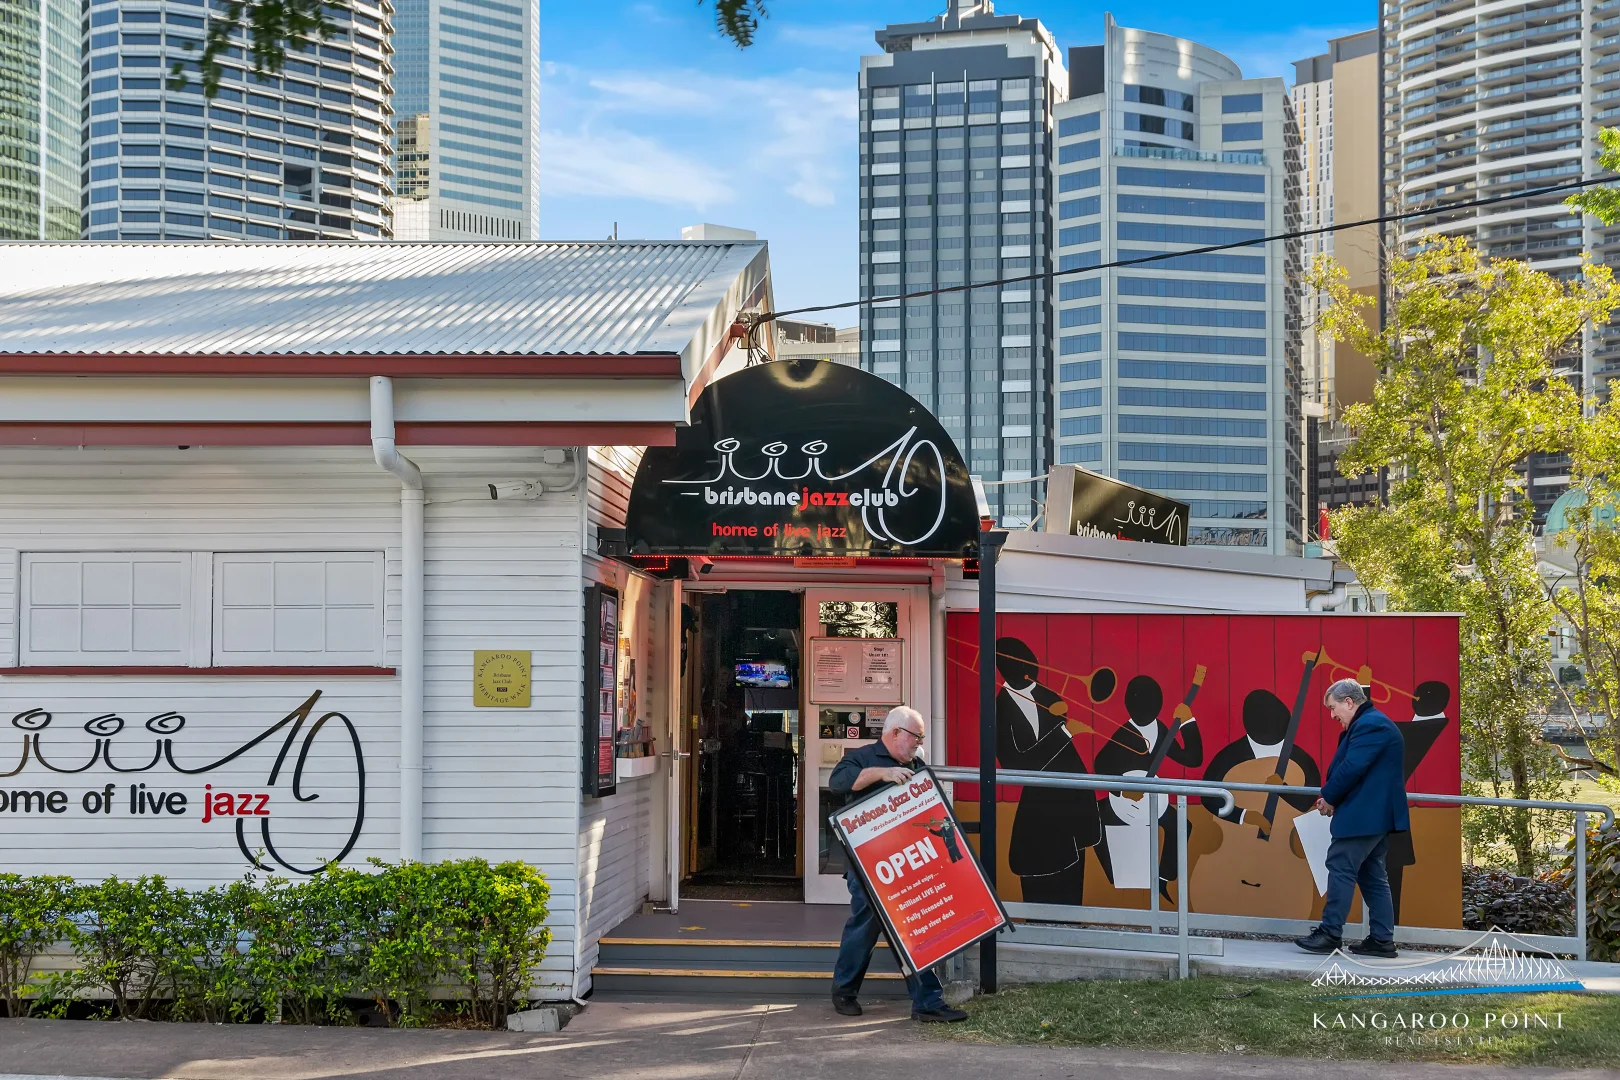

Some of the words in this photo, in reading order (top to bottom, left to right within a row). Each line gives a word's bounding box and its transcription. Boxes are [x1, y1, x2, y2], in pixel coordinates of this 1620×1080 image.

[712, 522, 758, 537] home
[763, 523, 779, 537] of
[784, 523, 811, 537] live
[816, 523, 847, 541] jazz
[478, 654, 512, 678] KANGAROO
[512, 658, 526, 678] POINT
[478, 683, 509, 703] HERITAGE
[510, 684, 526, 700] WALK
[82, 783, 116, 814] of
[130, 782, 188, 815] live
[202, 783, 271, 823] jazz
[841, 803, 889, 834] Brisbane
[888, 791, 911, 812] Jazz
[909, 778, 934, 798] Club
[902, 806, 918, 816] home
[875, 836, 939, 885] OPEN
[888, 892, 900, 901] Come
[912, 880, 922, 888] and
[898, 895, 922, 910] Brilliant
[922, 888, 934, 898] LIVE
[934, 882, 946, 893] jazz
[906, 912, 922, 923] Fully
[920, 898, 944, 916] licensed
[944, 894, 954, 902] bar
[912, 925, 928, 936] Huge
[928, 917, 942, 928] river
[942, 910, 956, 920] deck
